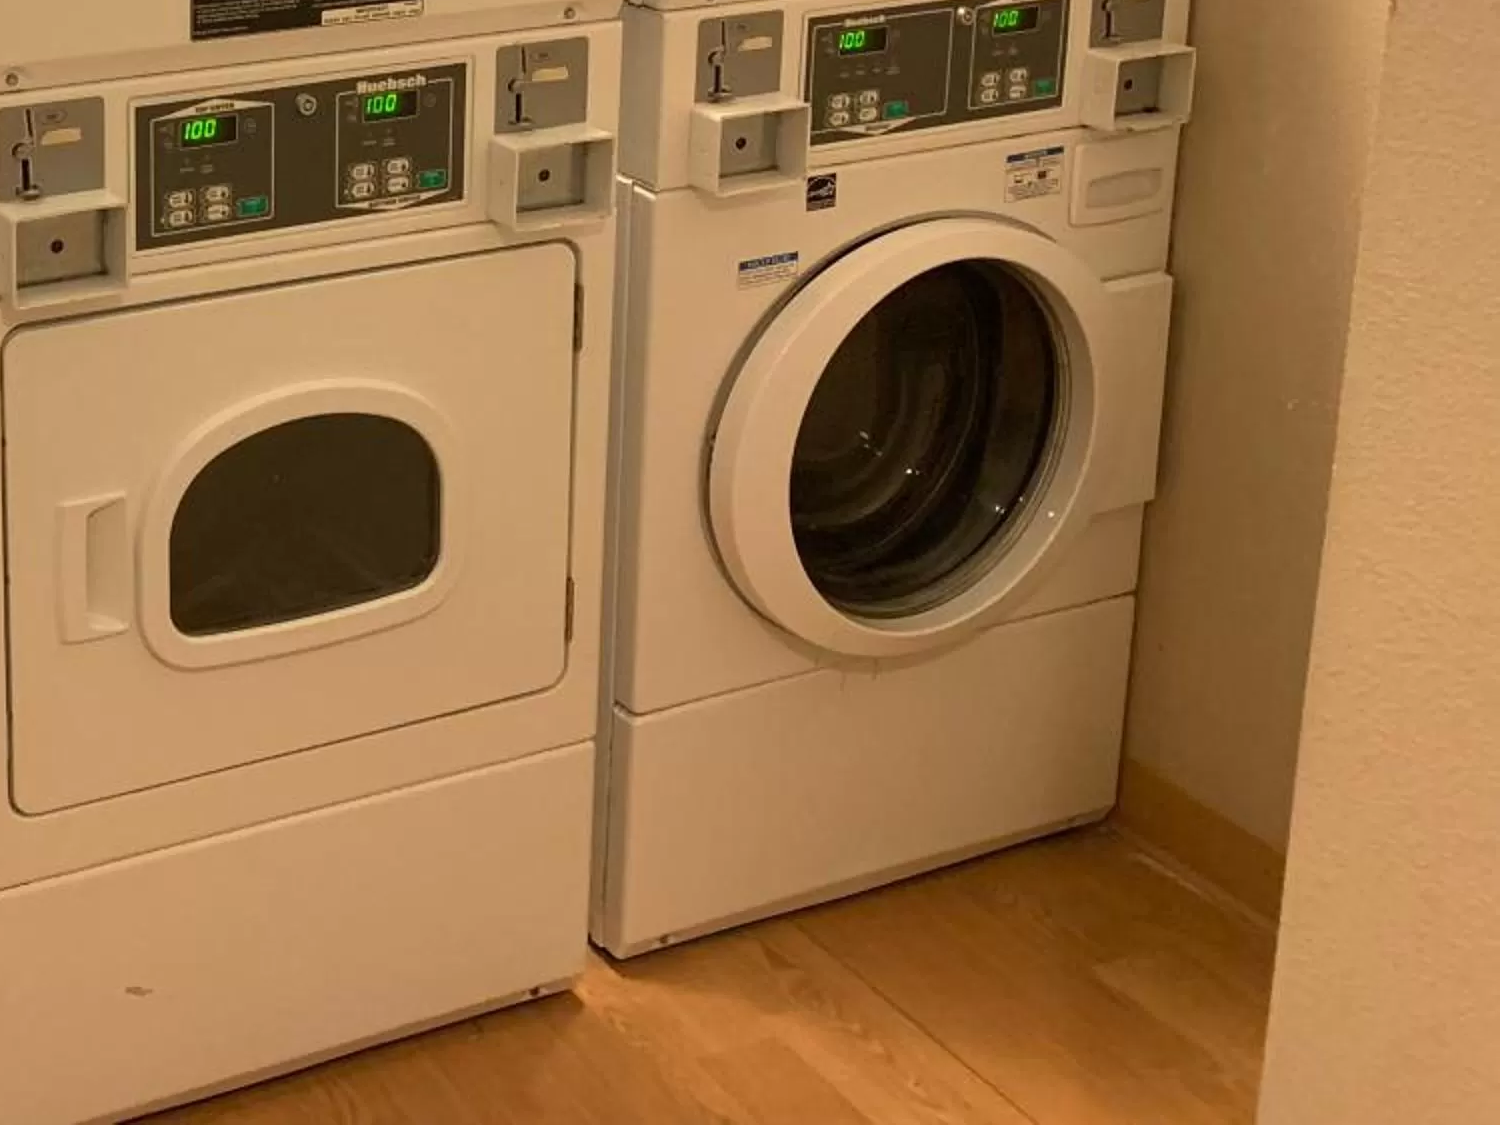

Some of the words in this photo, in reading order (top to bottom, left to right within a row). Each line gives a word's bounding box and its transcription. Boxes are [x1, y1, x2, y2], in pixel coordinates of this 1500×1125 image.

[993, 10, 1019, 28] 100
[839, 30, 865, 50] 100
[365, 94, 397, 114] 100
[184, 118, 217, 140] 100
